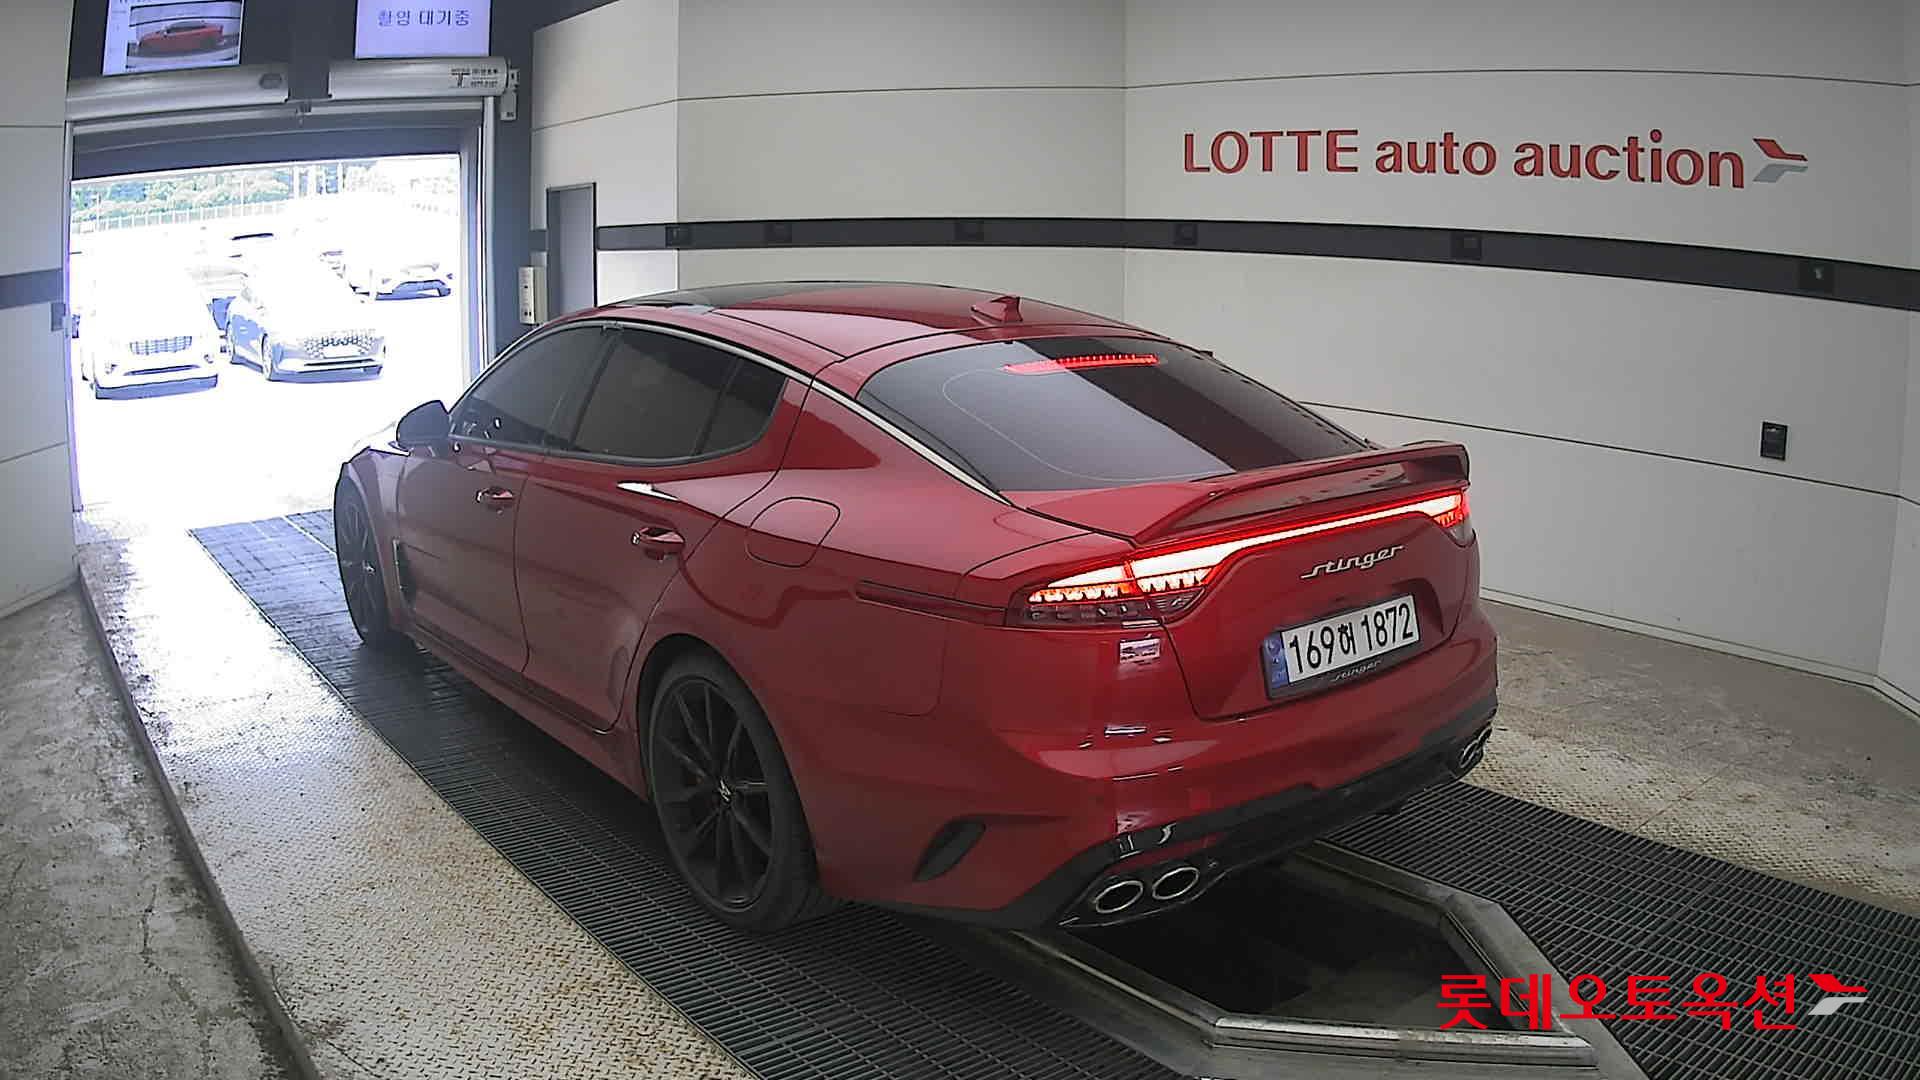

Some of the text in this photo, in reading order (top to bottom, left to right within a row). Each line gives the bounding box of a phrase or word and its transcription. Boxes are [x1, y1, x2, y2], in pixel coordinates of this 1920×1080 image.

[419, 9, 470, 26] 대기중
[1184, 129, 1746, 189] LOTTE auto auction
[1300, 545, 1404, 579] stinger
[1289, 602, 1414, 674] 169허 1872
